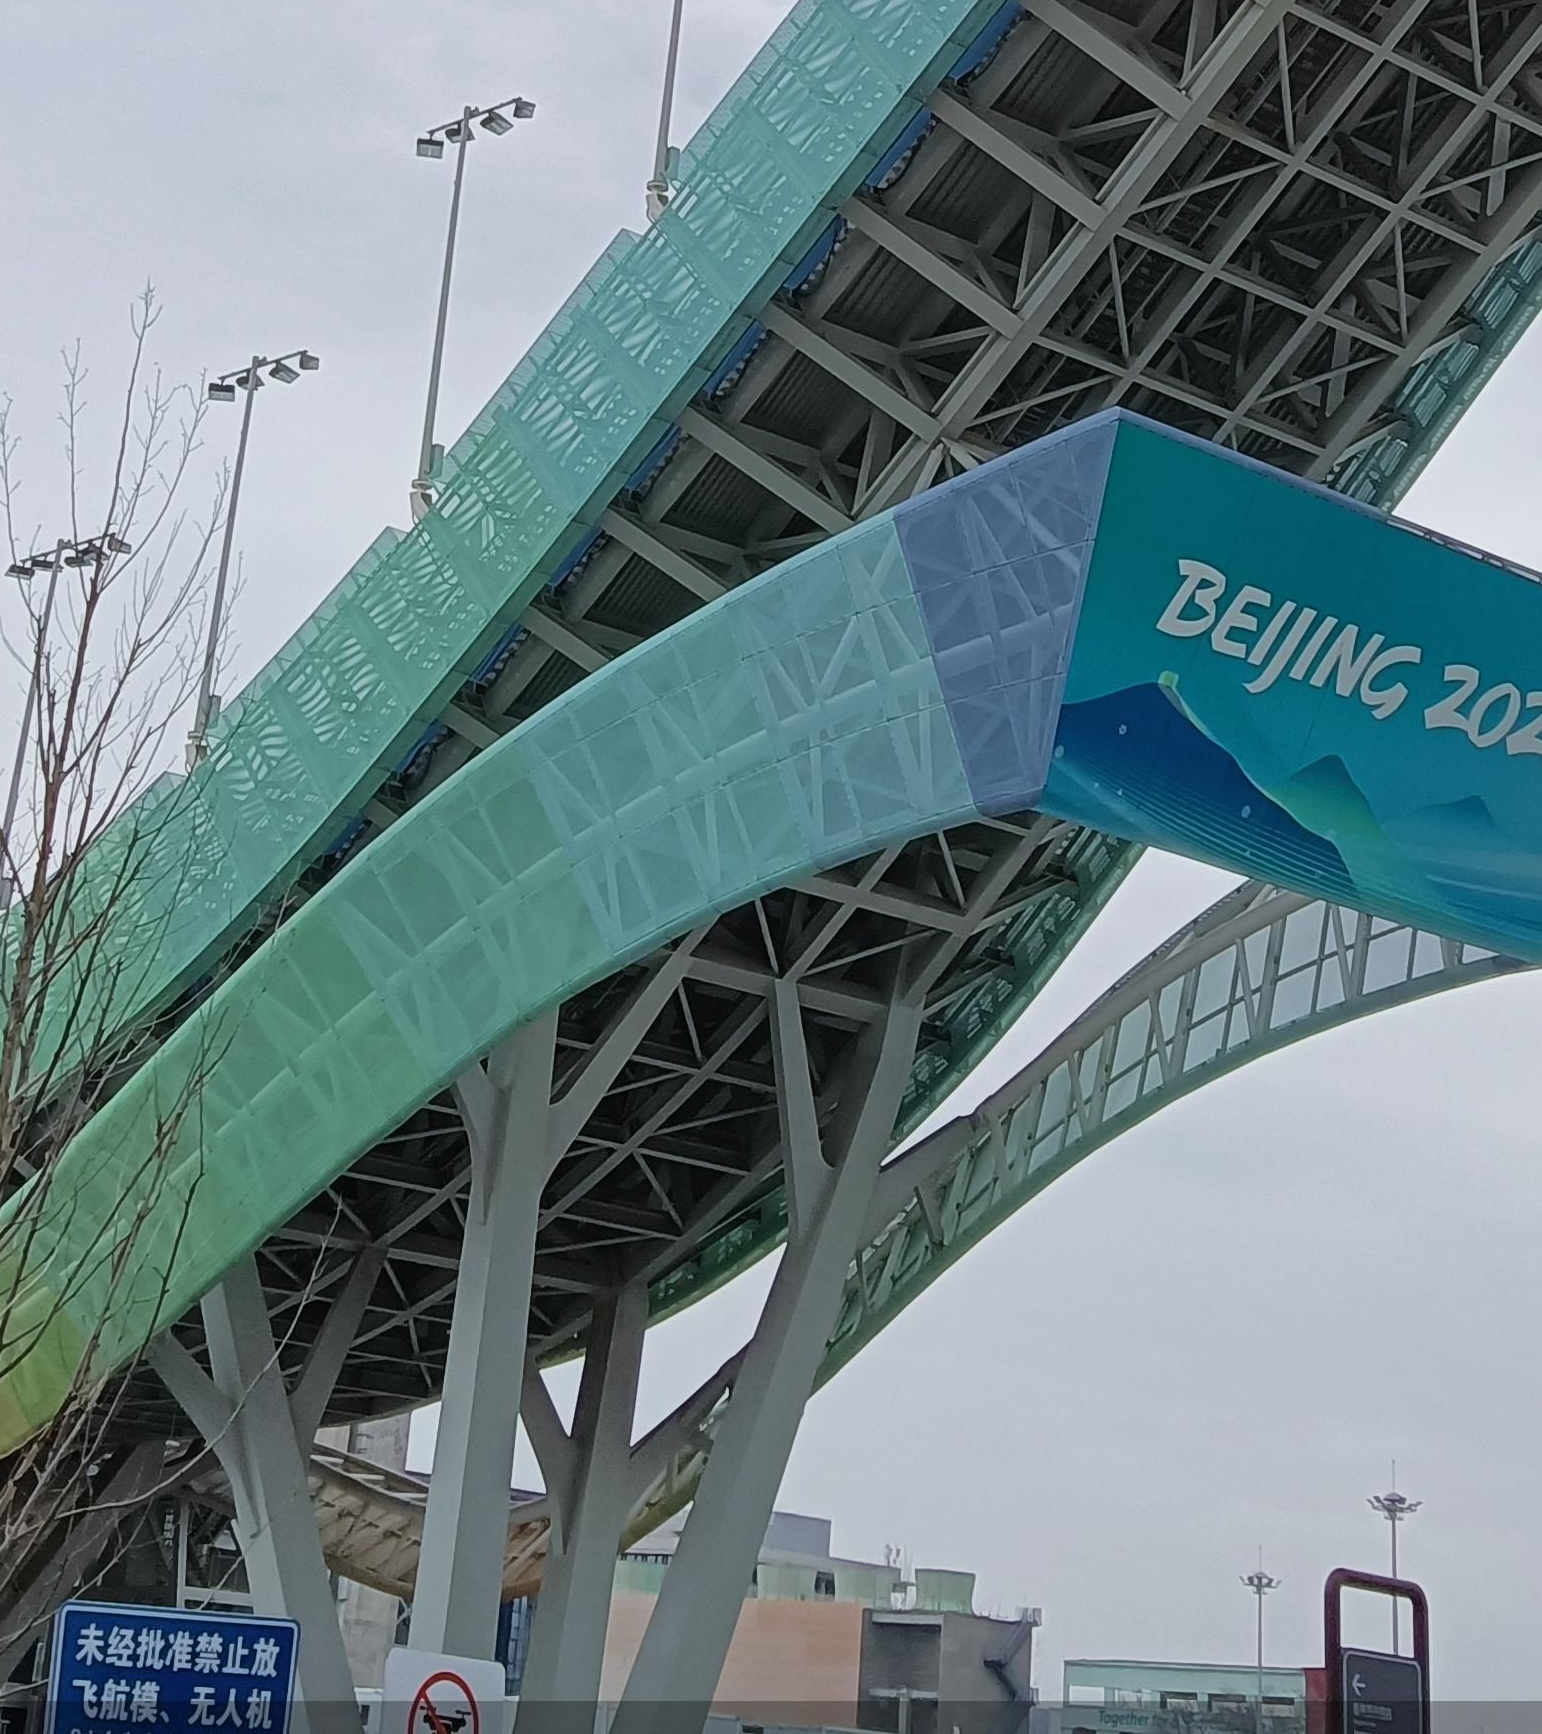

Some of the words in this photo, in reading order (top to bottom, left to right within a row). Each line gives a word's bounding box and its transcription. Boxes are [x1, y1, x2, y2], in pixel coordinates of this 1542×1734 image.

[1155, 559, 1422, 720] BEIJING
[75, 1622, 281, 1678] 未经批准禁止放
[72, 1679, 273, 1729] 飞航模、无人机
[1099, 1710, 1149, 1727] Together
